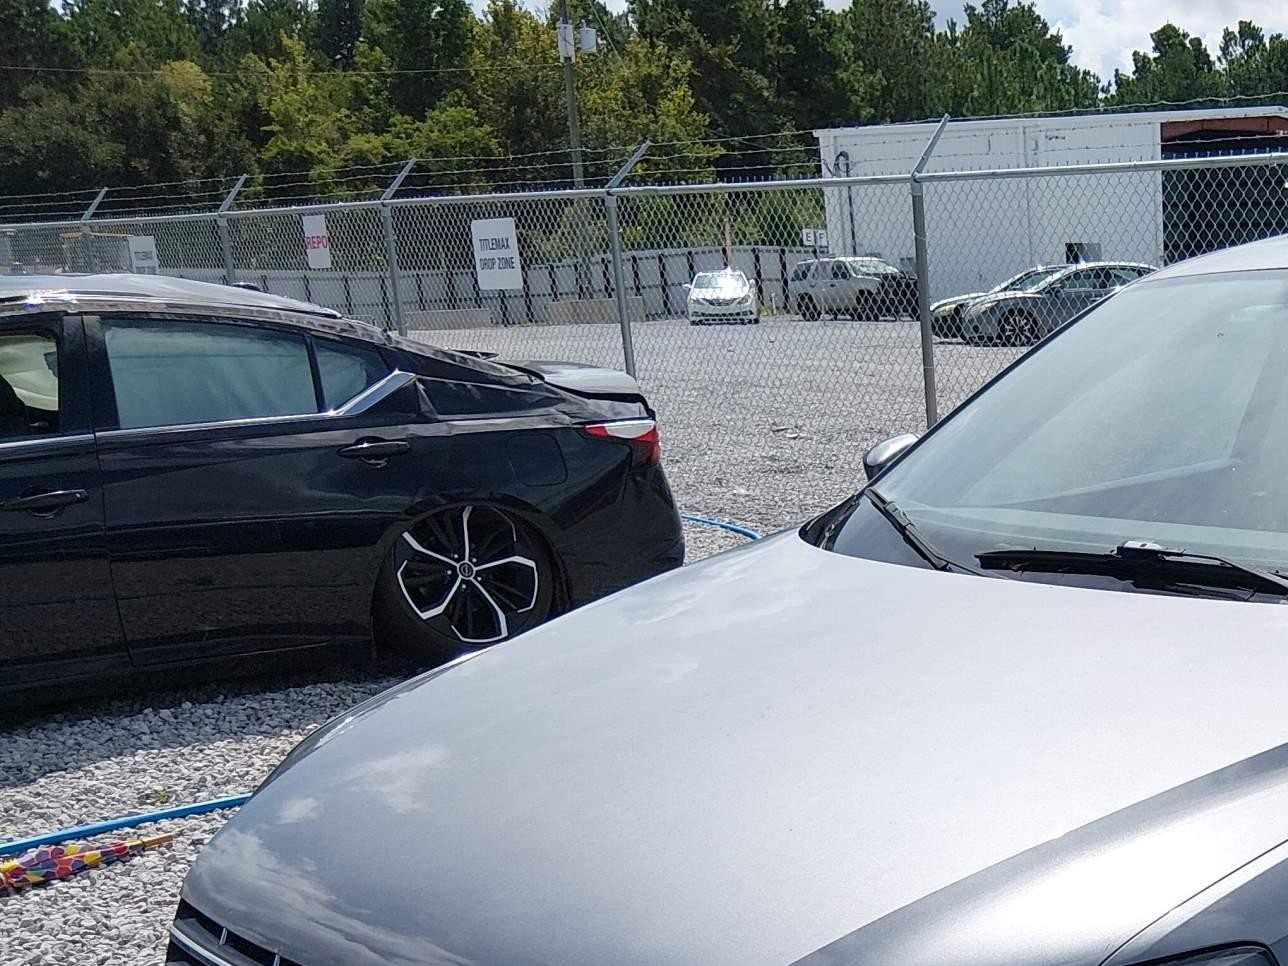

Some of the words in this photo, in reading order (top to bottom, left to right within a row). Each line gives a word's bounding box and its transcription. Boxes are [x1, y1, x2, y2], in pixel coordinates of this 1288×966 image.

[304, 235, 328, 249] REPO
[479, 237, 511, 251] TITLEMAX
[480, 257, 496, 270] DROP
[497, 256, 516, 270] ZONE
